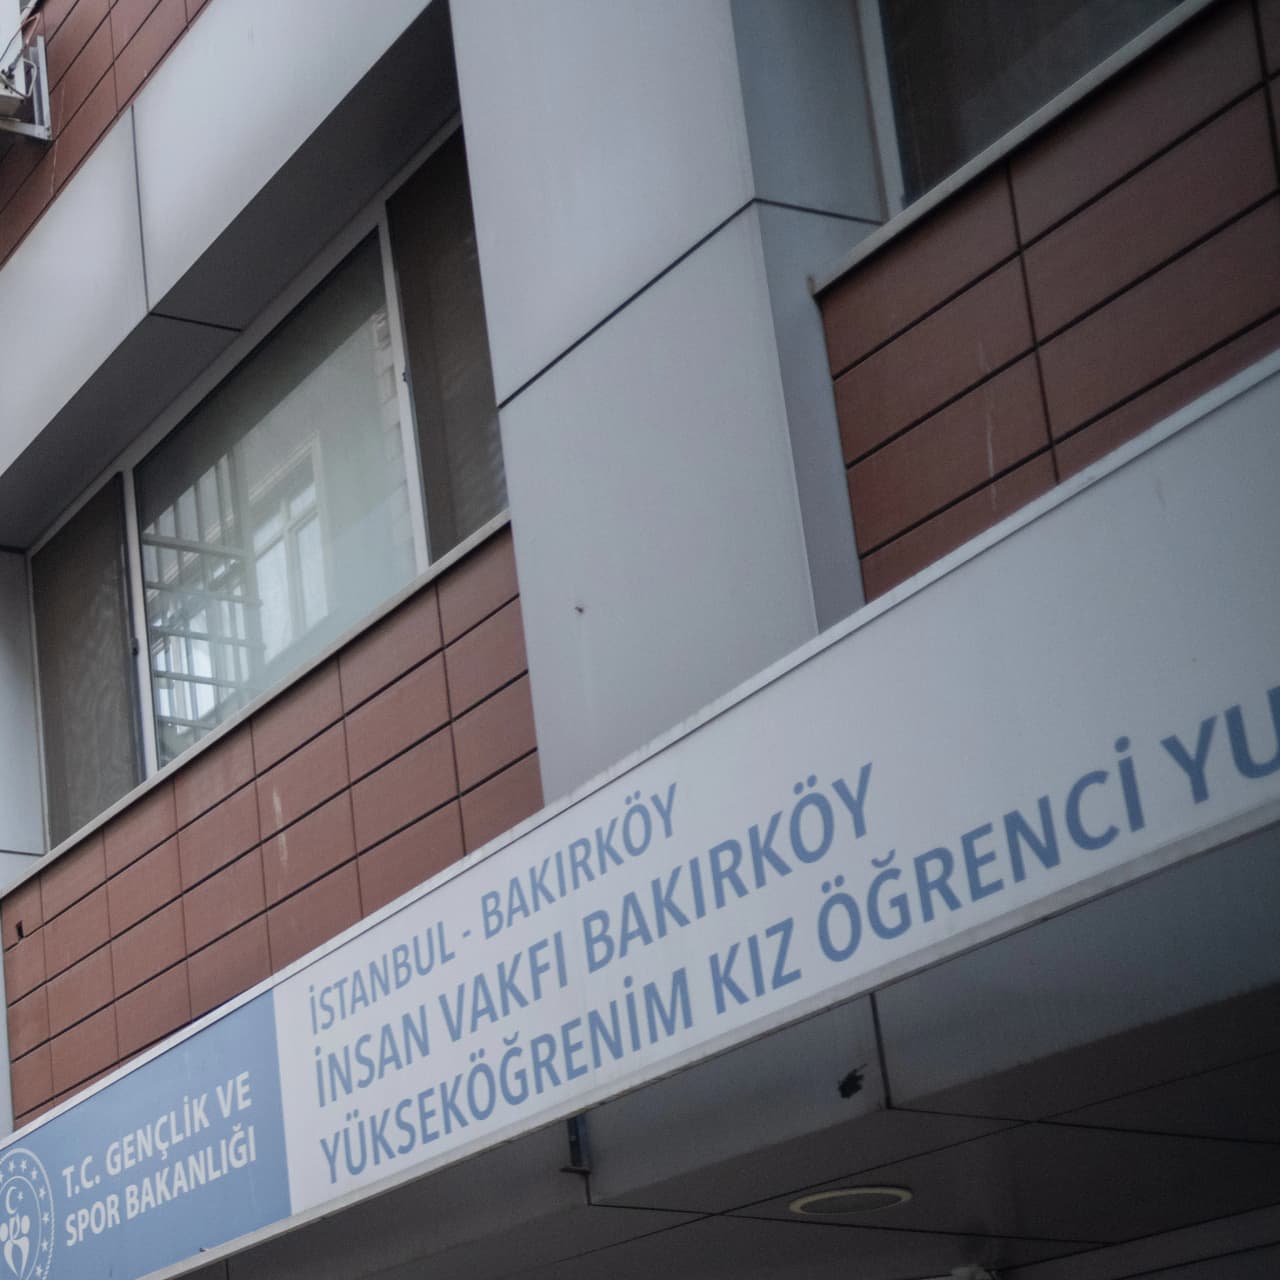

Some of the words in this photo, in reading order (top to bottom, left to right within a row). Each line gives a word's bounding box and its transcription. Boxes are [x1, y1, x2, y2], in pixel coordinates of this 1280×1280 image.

[309, 920, 456, 1035] İSTANBUL
[480, 782, 678, 940] BAKIRKÖY
[314, 1005, 430, 1108] İNSAN
[439, 931, 568, 1042] VAKFI
[582, 762, 873, 974] BAKIRKÖY
[319, 968, 694, 1185] YÜKSEKÖĞRENİM
[708, 917, 802, 1015] KIZ
[817, 736, 1145, 962] ÖĞRENCİ
[61, 1154, 101, 1199] T.C.
[105, 1094, 210, 1178] GENÇLİK
[216, 1070, 253, 1120] VE
[65, 1193, 121, 1247] SPOR
[126, 1125, 257, 1220] BAKANLIĞI
